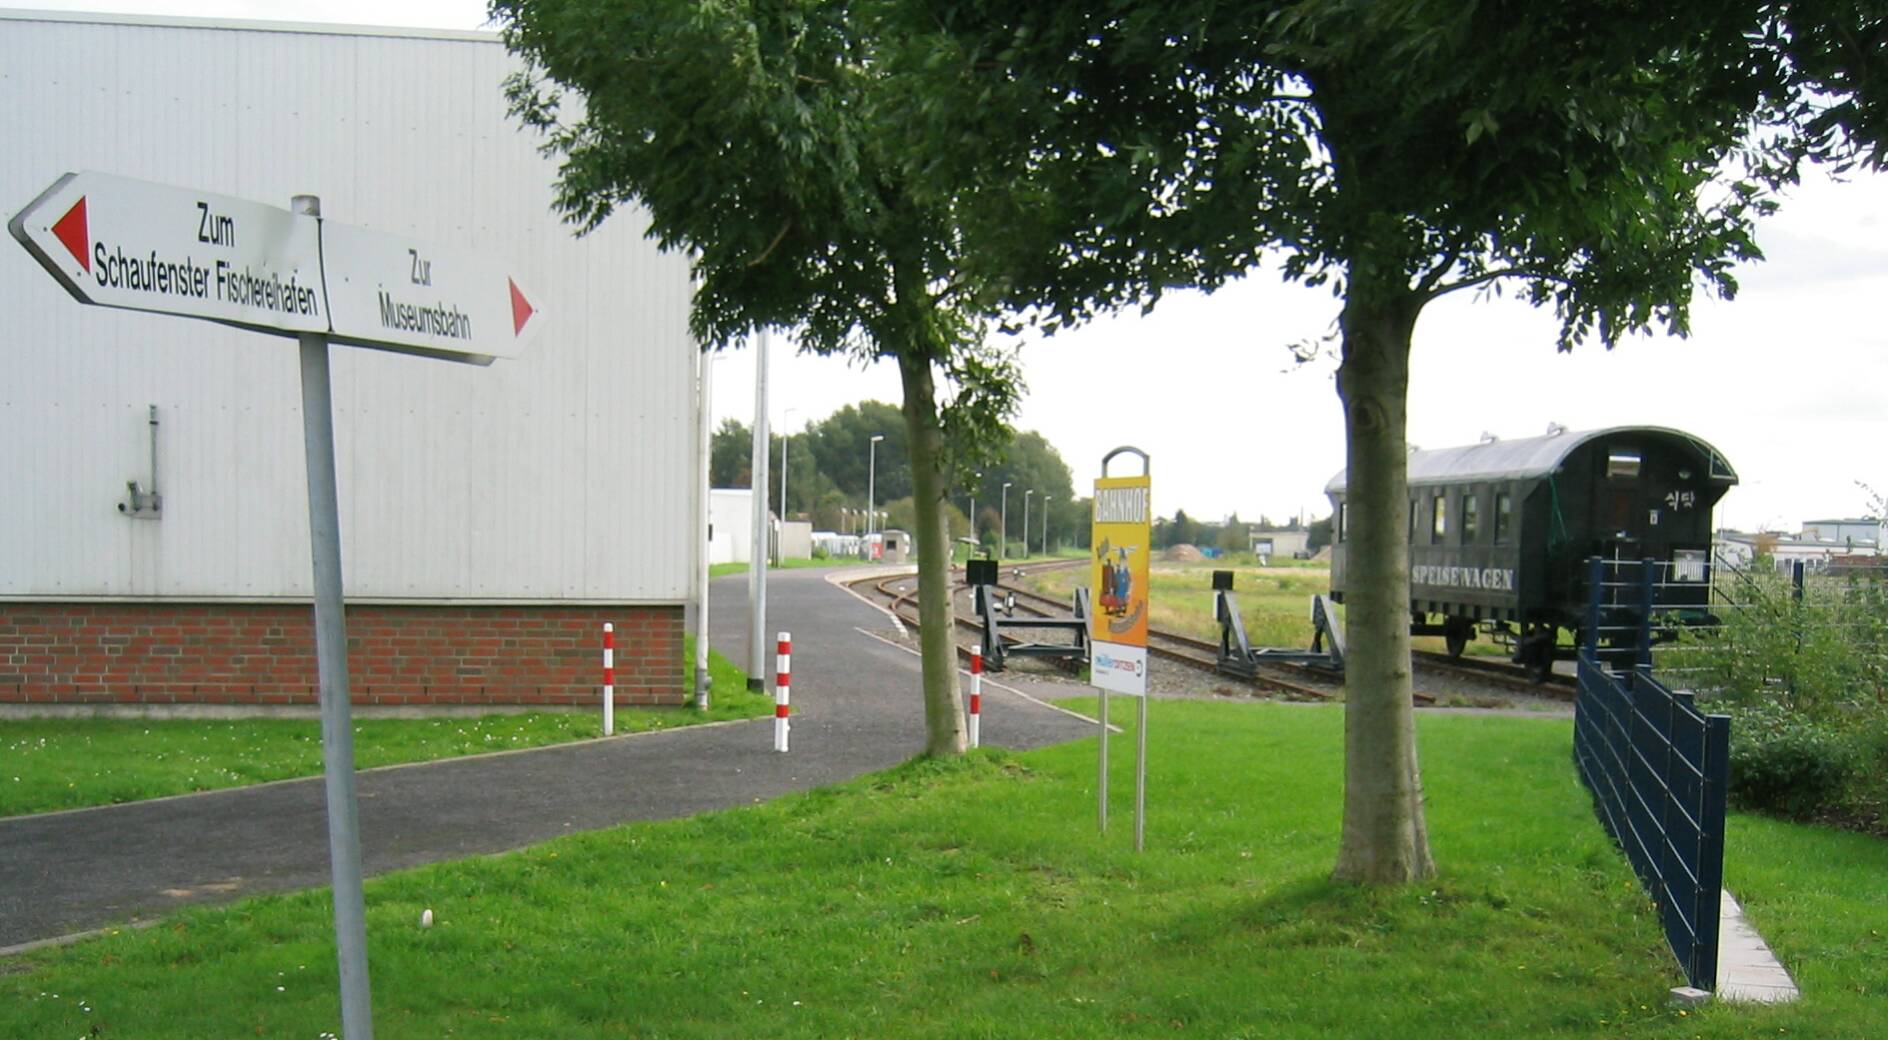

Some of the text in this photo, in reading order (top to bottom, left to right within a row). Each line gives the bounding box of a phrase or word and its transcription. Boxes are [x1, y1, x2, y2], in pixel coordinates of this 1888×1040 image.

[197, 202, 234, 247] Zum
[95, 241, 319, 316] Schaufenster Fischereihafen
[408, 248, 431, 286] Zur
[378, 290, 472, 340] Museumsbahn
[1095, 488, 1148, 522] BAHNHOF
[1665, 490, 1695, 511] 식당
[1411, 565, 1514, 590] SPEISEWAGEN
